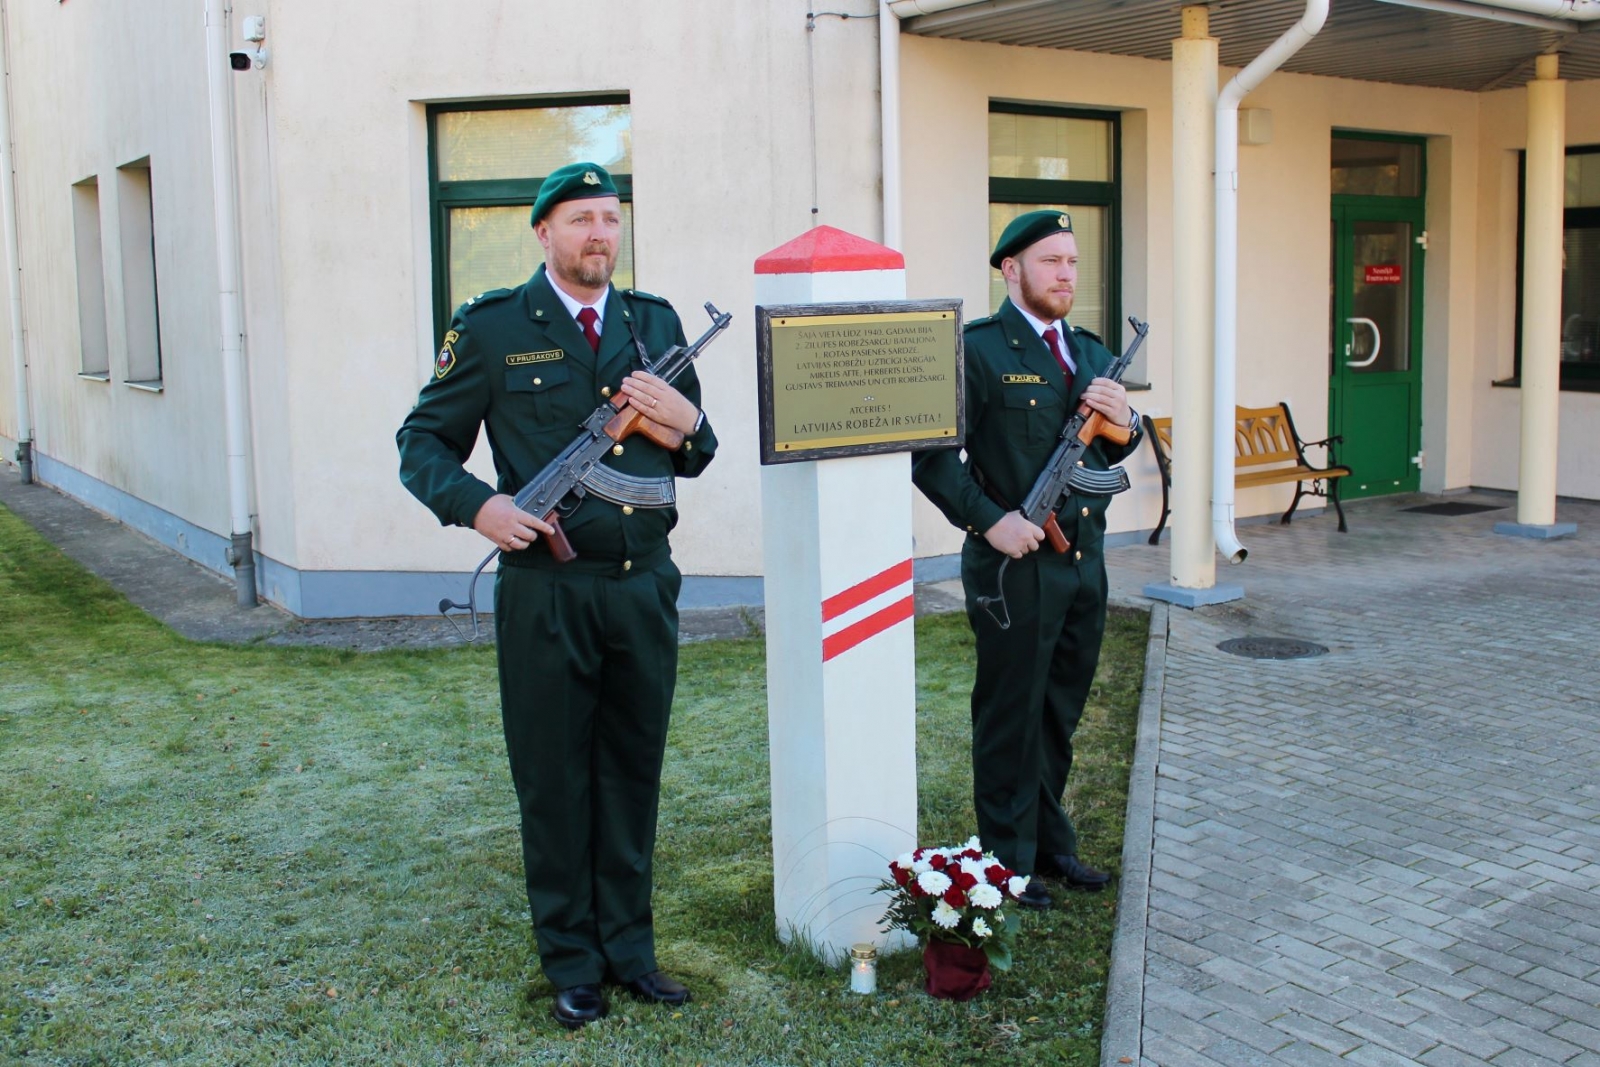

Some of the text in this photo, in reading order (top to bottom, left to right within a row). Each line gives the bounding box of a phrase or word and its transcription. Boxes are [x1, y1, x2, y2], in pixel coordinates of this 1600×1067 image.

[886, 327, 916, 335] GADAM
[804, 340, 837, 349] ZILUPES
[838, 338, 891, 347] ROBEŽSARGU
[516, 351, 560, 362] PRUSAKOVS
[823, 350, 850, 358] ROTAS
[851, 348, 886, 357] PASIENES
[797, 361, 831, 370] LATVIJAS
[833, 359, 866, 368] ROBEŽU
[864, 367, 901, 376] HERBERTS
[785, 382, 823, 391] GUSTAVS
[825, 379, 866, 388] TREIMANIS
[868, 378, 881, 386] UN
[882, 377, 897, 385] CITI
[849, 405, 886, 415] ATCERIES
[794, 421, 843, 434] LATVIJAS
[846, 416, 889, 430] ROBEŽA
[891, 416, 902, 426] IR
[904, 413, 936, 425] SVĒTA
